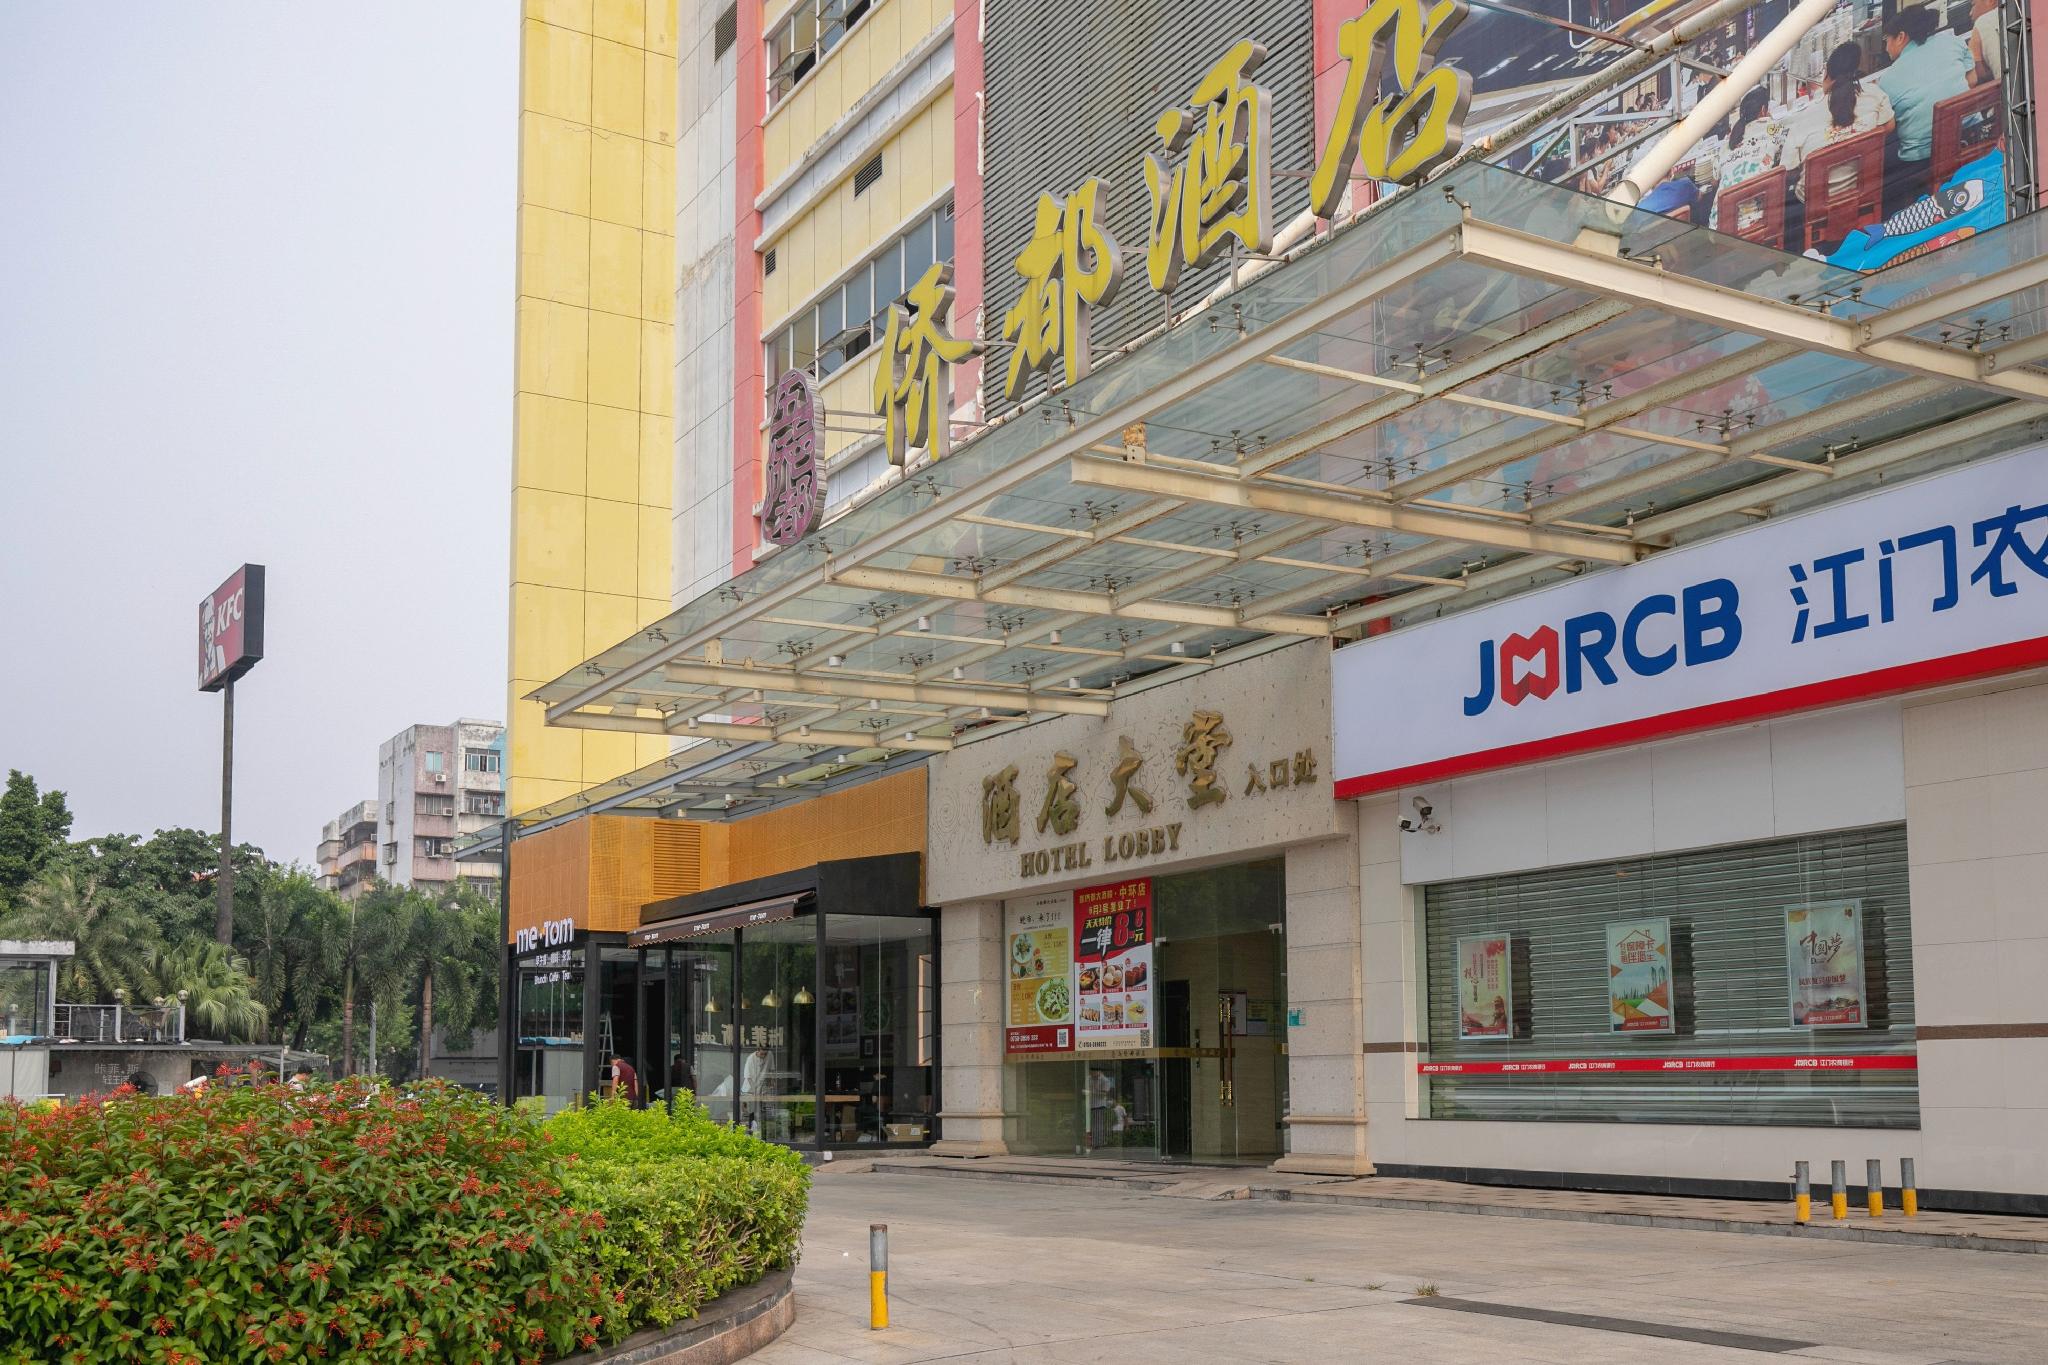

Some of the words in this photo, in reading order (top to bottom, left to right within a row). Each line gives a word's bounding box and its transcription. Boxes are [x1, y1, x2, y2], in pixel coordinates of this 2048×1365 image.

[873, 0, 1473, 467] 侨都酒店
[216, 587, 243, 637] KFC
[1788, 502, 2048, 645] 江门农
[982, 710, 1233, 847] 酒店大堂
[1244, 747, 1318, 797] 入口处
[1020, 841, 1092, 878] HOTEL
[1104, 822, 1183, 863] LOBBY
